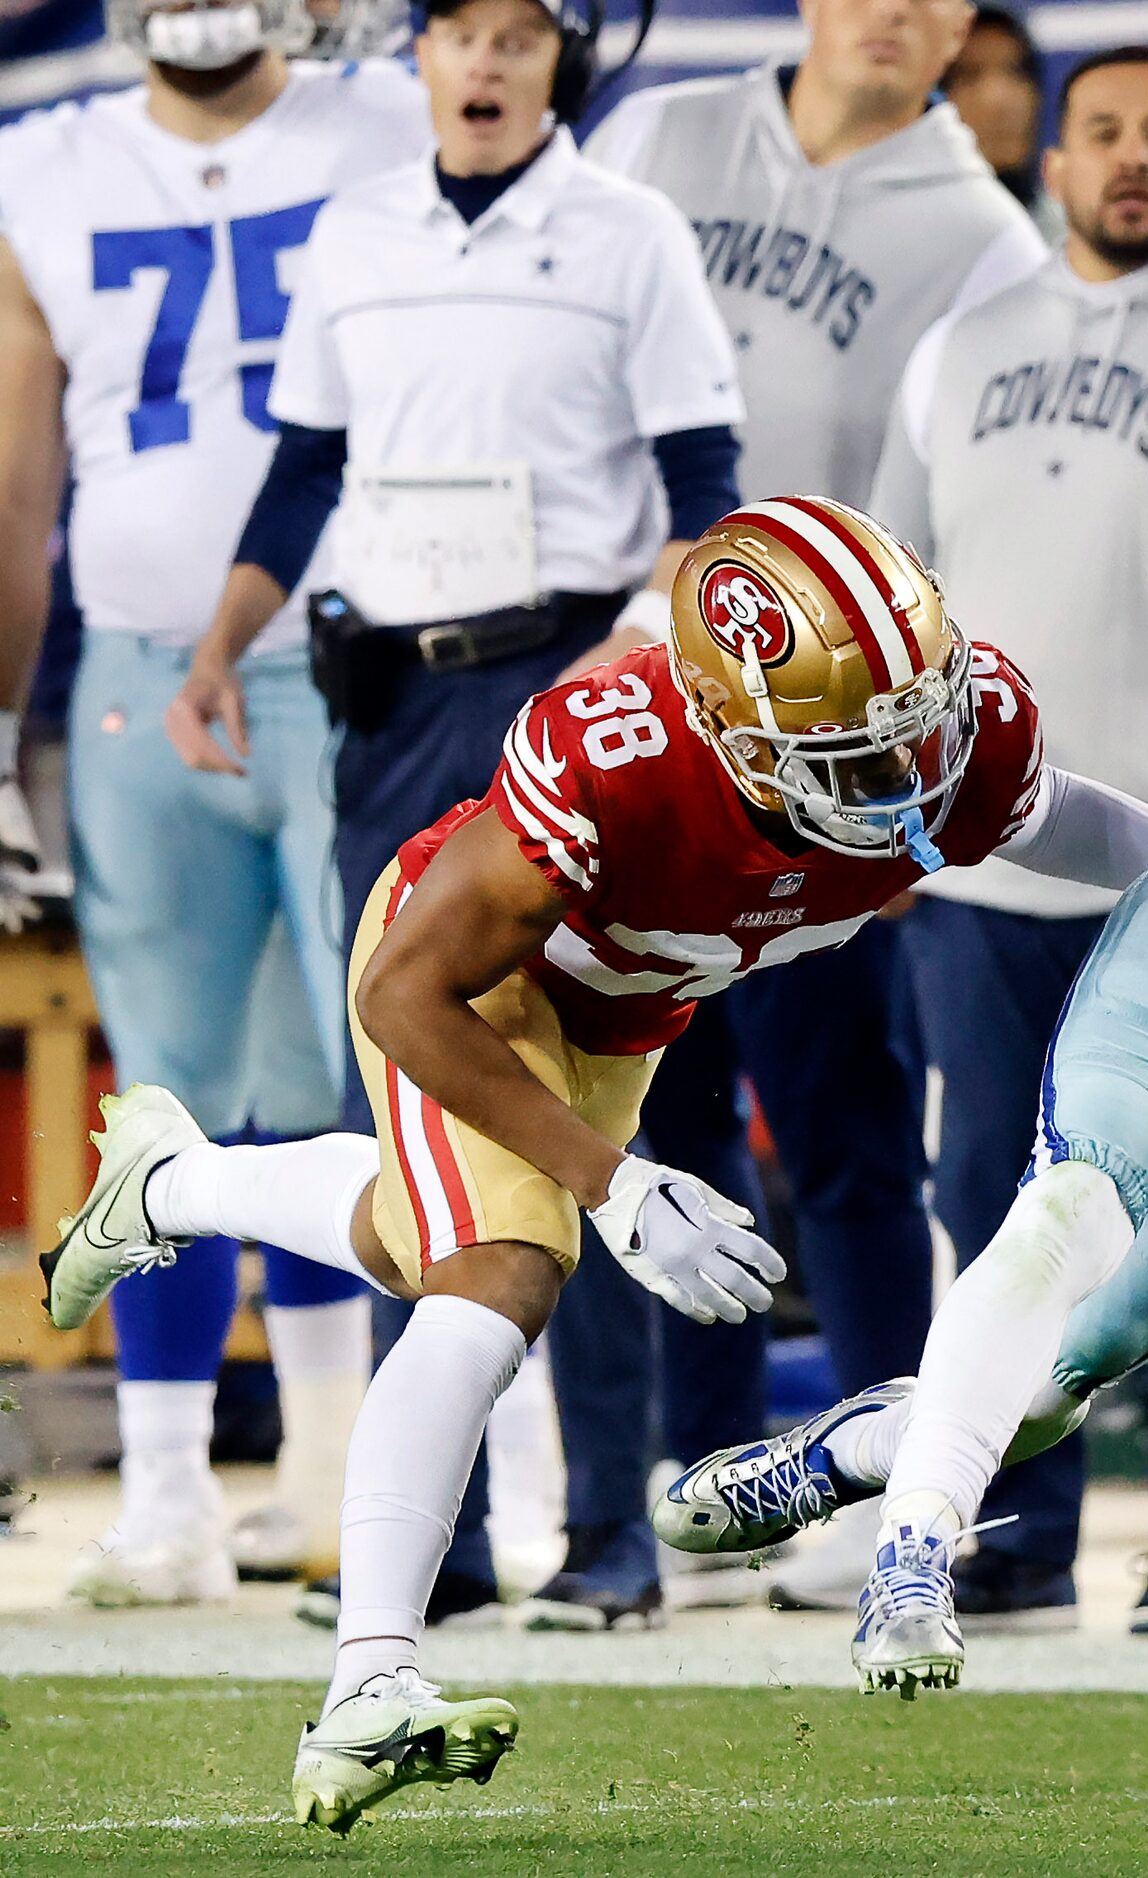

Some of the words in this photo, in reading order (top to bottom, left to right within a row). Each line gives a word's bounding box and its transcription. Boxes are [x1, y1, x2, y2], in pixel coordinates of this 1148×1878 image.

[93, 197, 332, 452] 75
[691, 220, 875, 351] OWBOYS
[565, 673, 669, 771] 38
